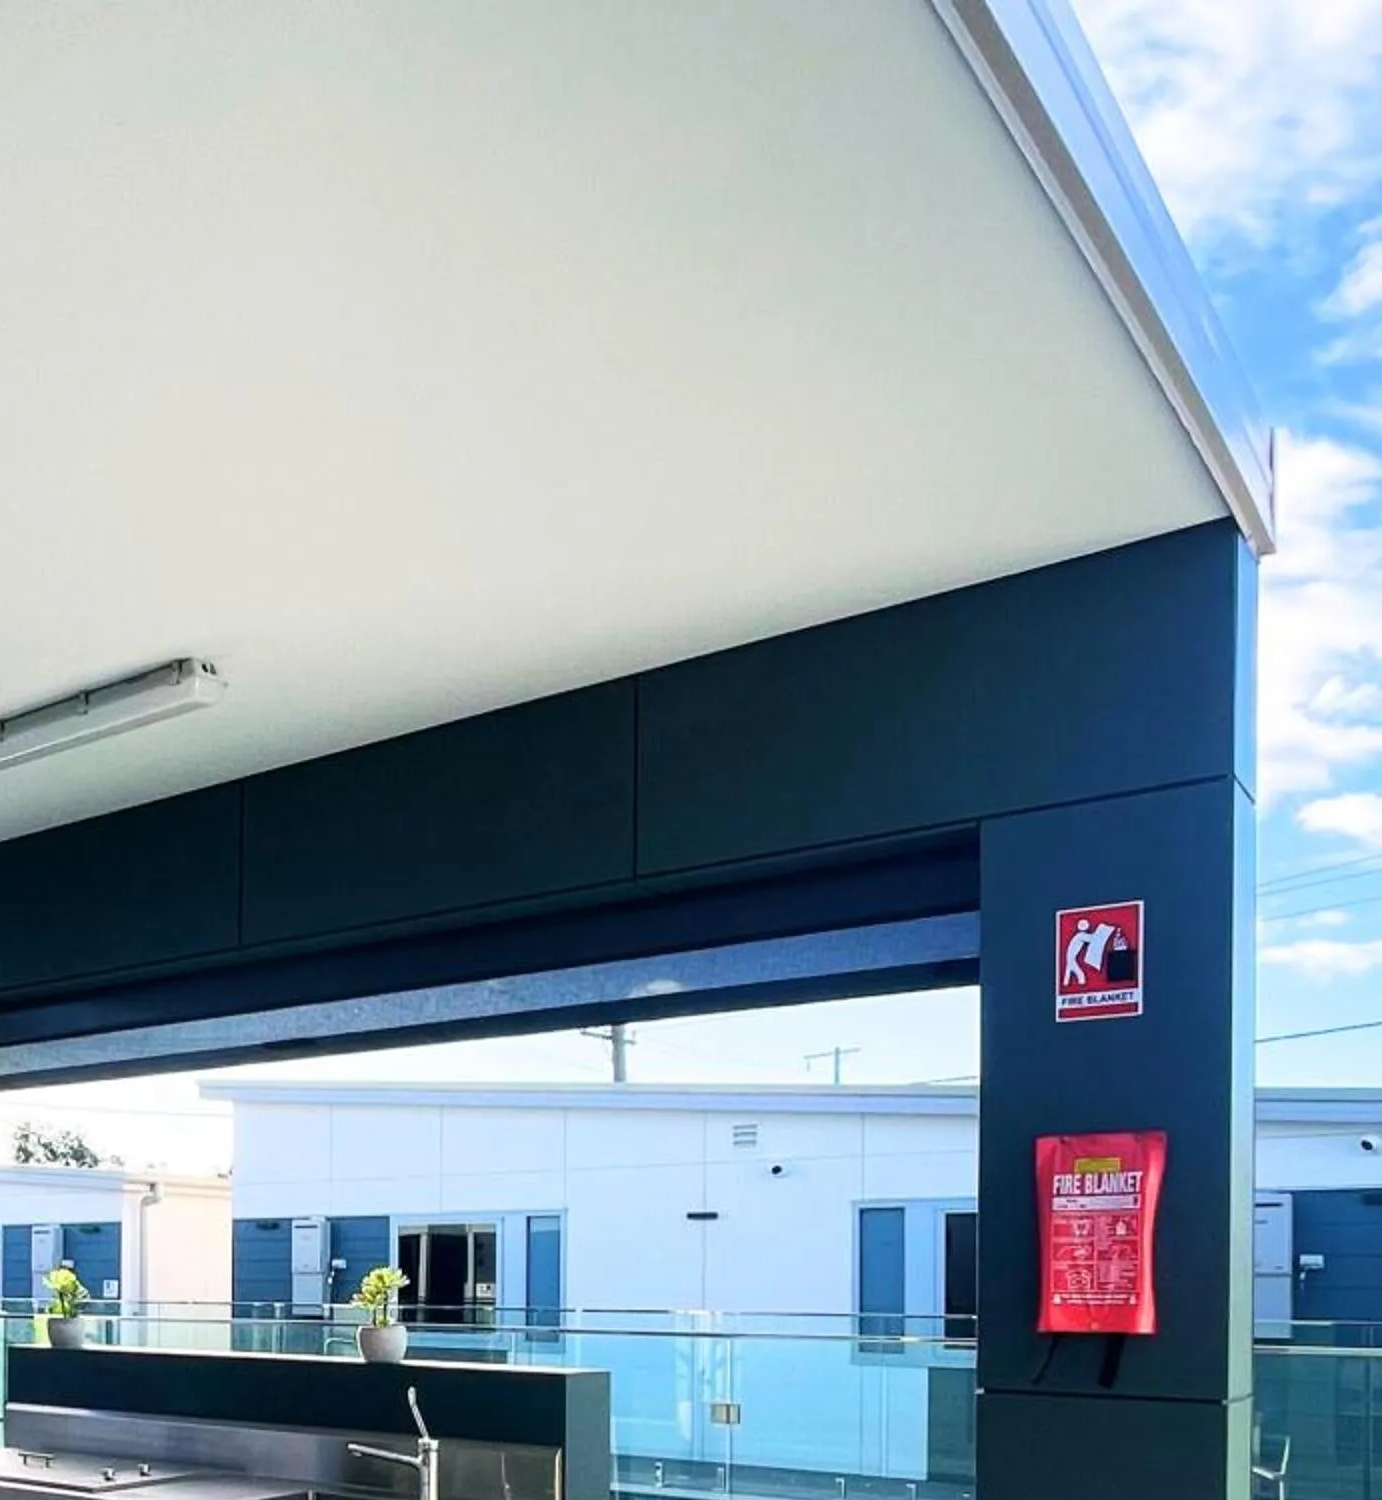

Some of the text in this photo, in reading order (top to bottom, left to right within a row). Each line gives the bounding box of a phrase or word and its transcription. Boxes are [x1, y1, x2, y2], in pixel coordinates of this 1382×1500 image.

[1061, 992, 1134, 1005] FIRE BLANKET
[1053, 1171, 1143, 1195] FIRE BLANKET
